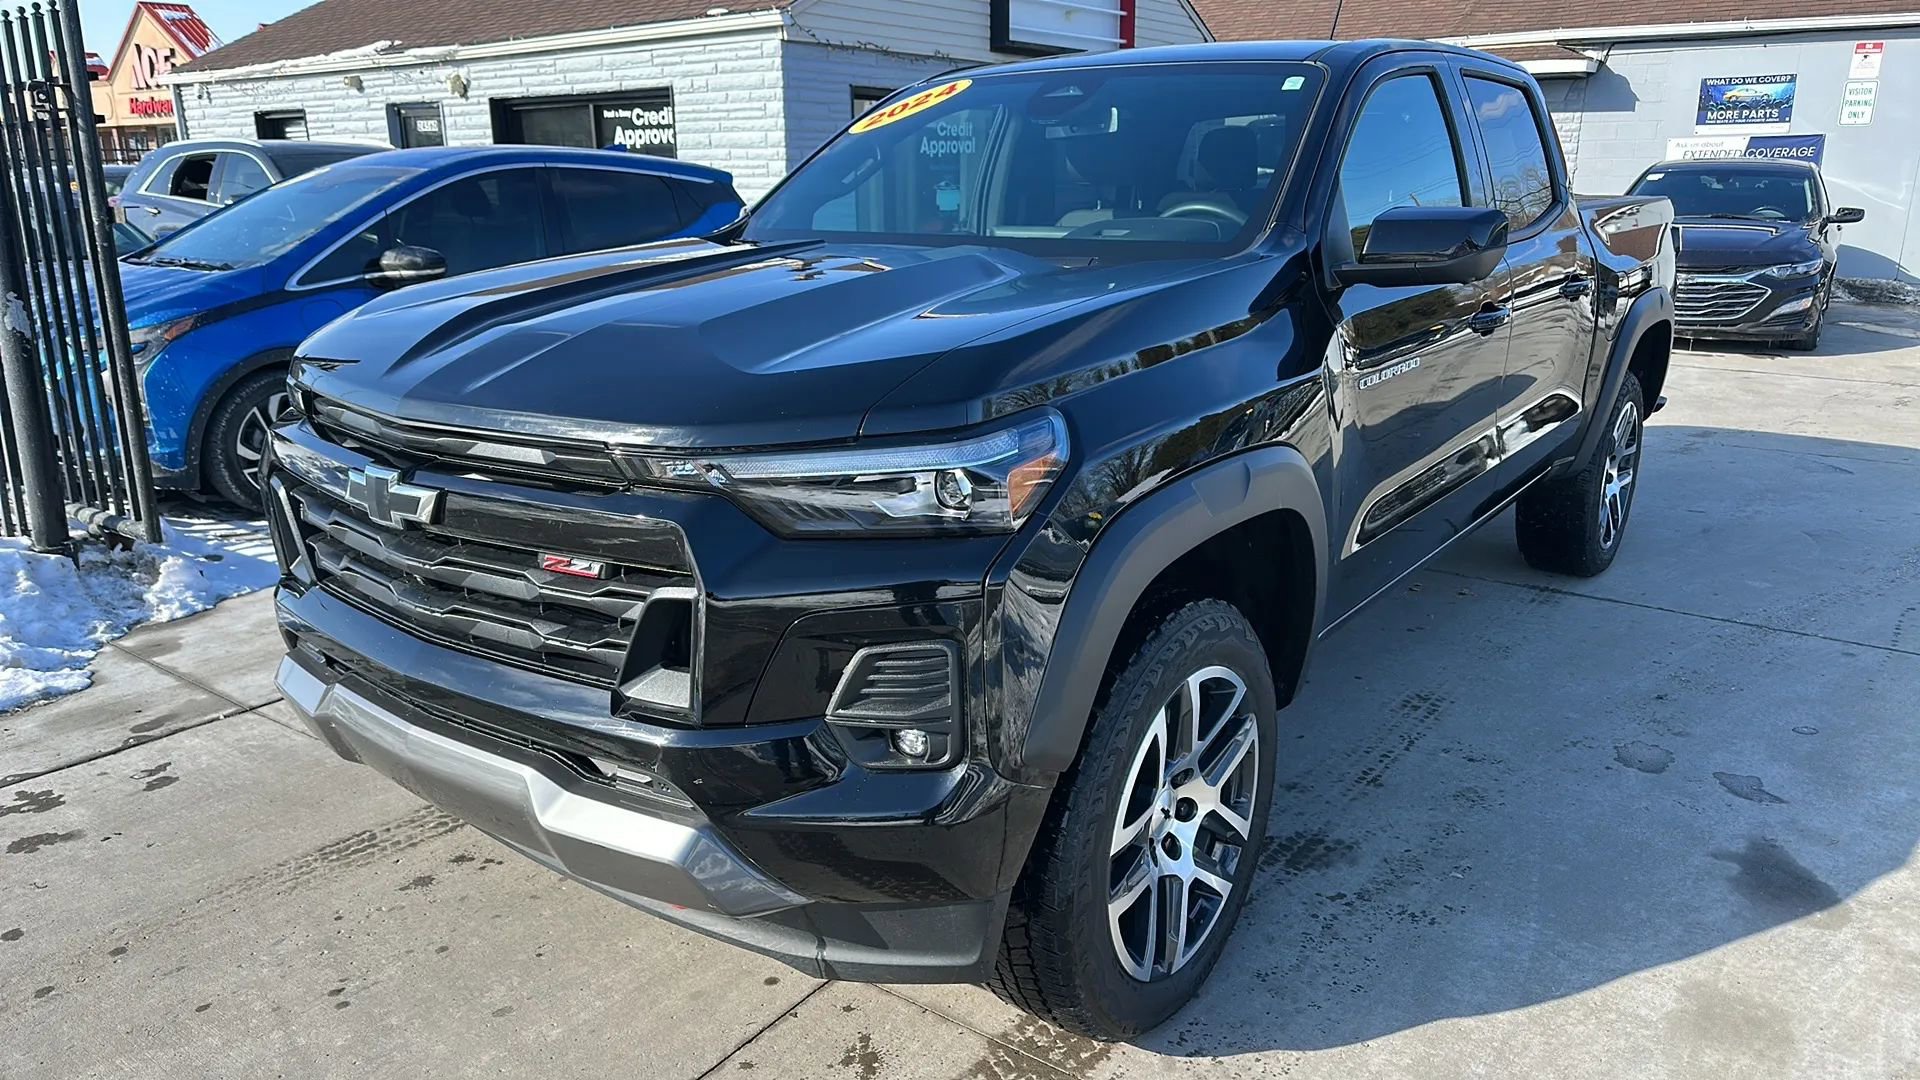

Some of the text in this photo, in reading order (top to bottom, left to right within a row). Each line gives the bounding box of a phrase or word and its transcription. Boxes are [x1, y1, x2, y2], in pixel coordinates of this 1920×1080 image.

[131, 44, 174, 90] ACE
[1706, 78, 1730, 86] WHAT
[1731, 77, 1743, 85] DO
[1758, 75, 1791, 83] COVER?
[1848, 87, 1873, 96] VISITOR
[129, 97, 174, 115] Hardwar
[862, 83, 958, 129] 2024
[1844, 99, 1873, 108] PARKING
[631, 106, 673, 126] Credi
[1707, 108, 1779, 120] MORE PARTS
[1847, 110, 1866, 119] ONLY
[614, 125, 675, 149] Approva
[937, 121, 973, 137] Credit
[920, 136, 976, 157] Approval
[1682, 146, 1817, 160] EXTENDED COVERAGE
[1359, 357, 1420, 390] COLORADO
[543, 554, 600, 579] Z71
